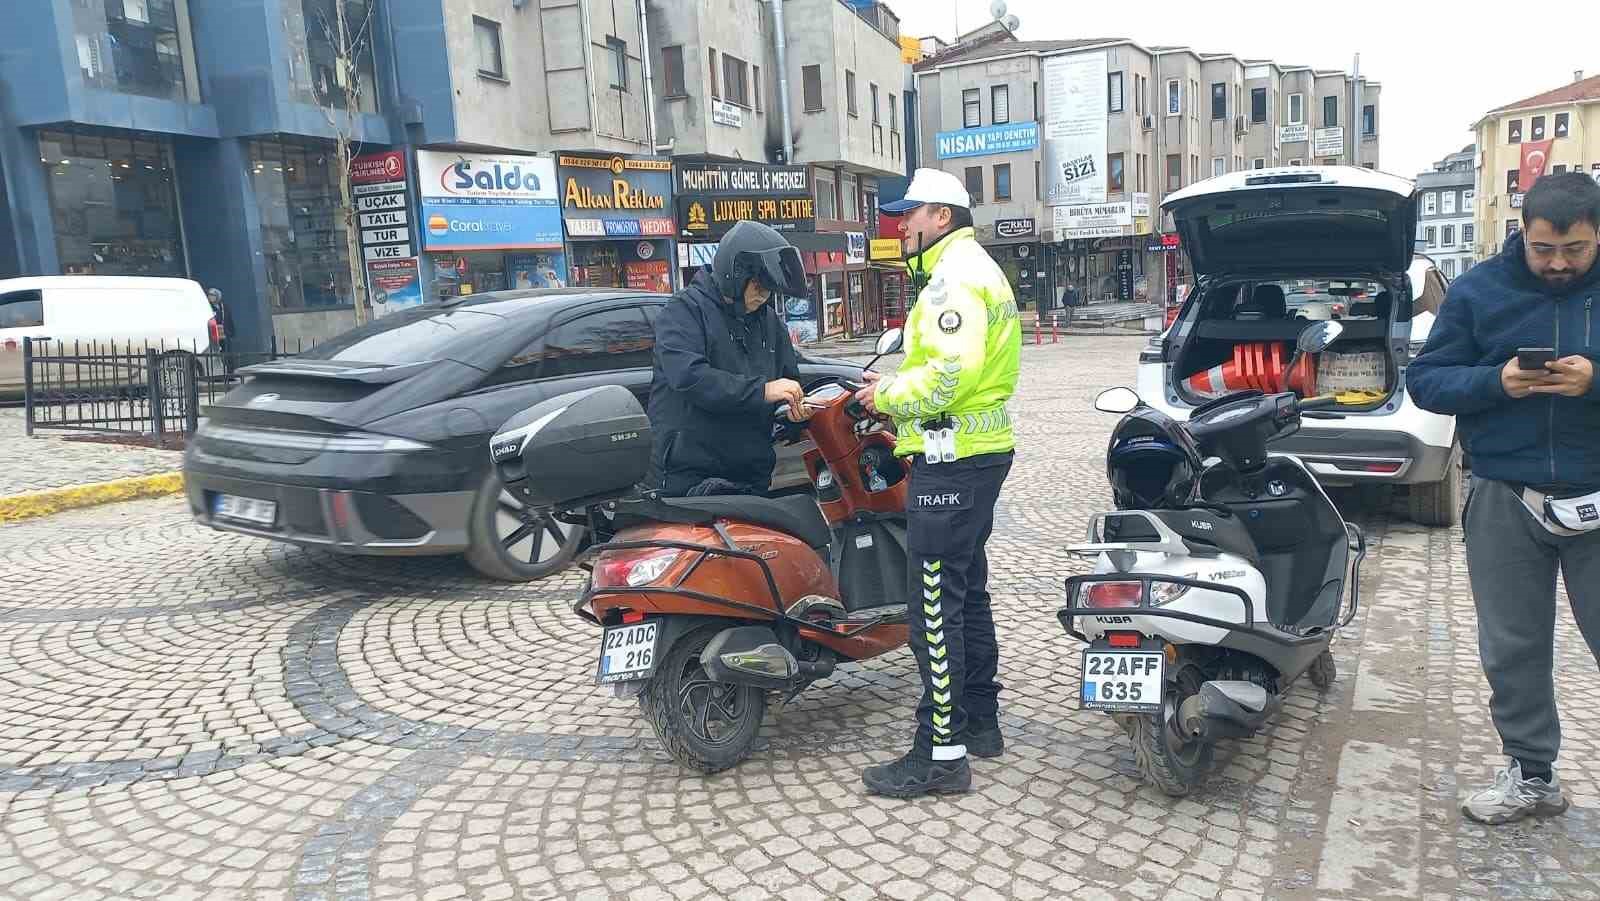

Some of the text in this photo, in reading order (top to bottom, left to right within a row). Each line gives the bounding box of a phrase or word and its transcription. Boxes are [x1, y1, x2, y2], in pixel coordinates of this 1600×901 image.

[454, 160, 541, 191] Salda
[682, 165, 806, 192] MUHİTTİN GÜNEL İŞ MERKEZİ
[1064, 159, 1096, 181] SİZİ
[364, 195, 399, 209] UÇAK
[713, 199, 815, 222] LUXURY SPA CENTRE
[367, 212, 400, 225] TATİL
[373, 230, 398, 241] TUR
[374, 246, 401, 257] VİZE
[611, 432, 638, 442] SH34
[607, 625, 655, 650] 22 ADC
[625, 648, 652, 670] 216
[1101, 681, 1143, 701] 635
